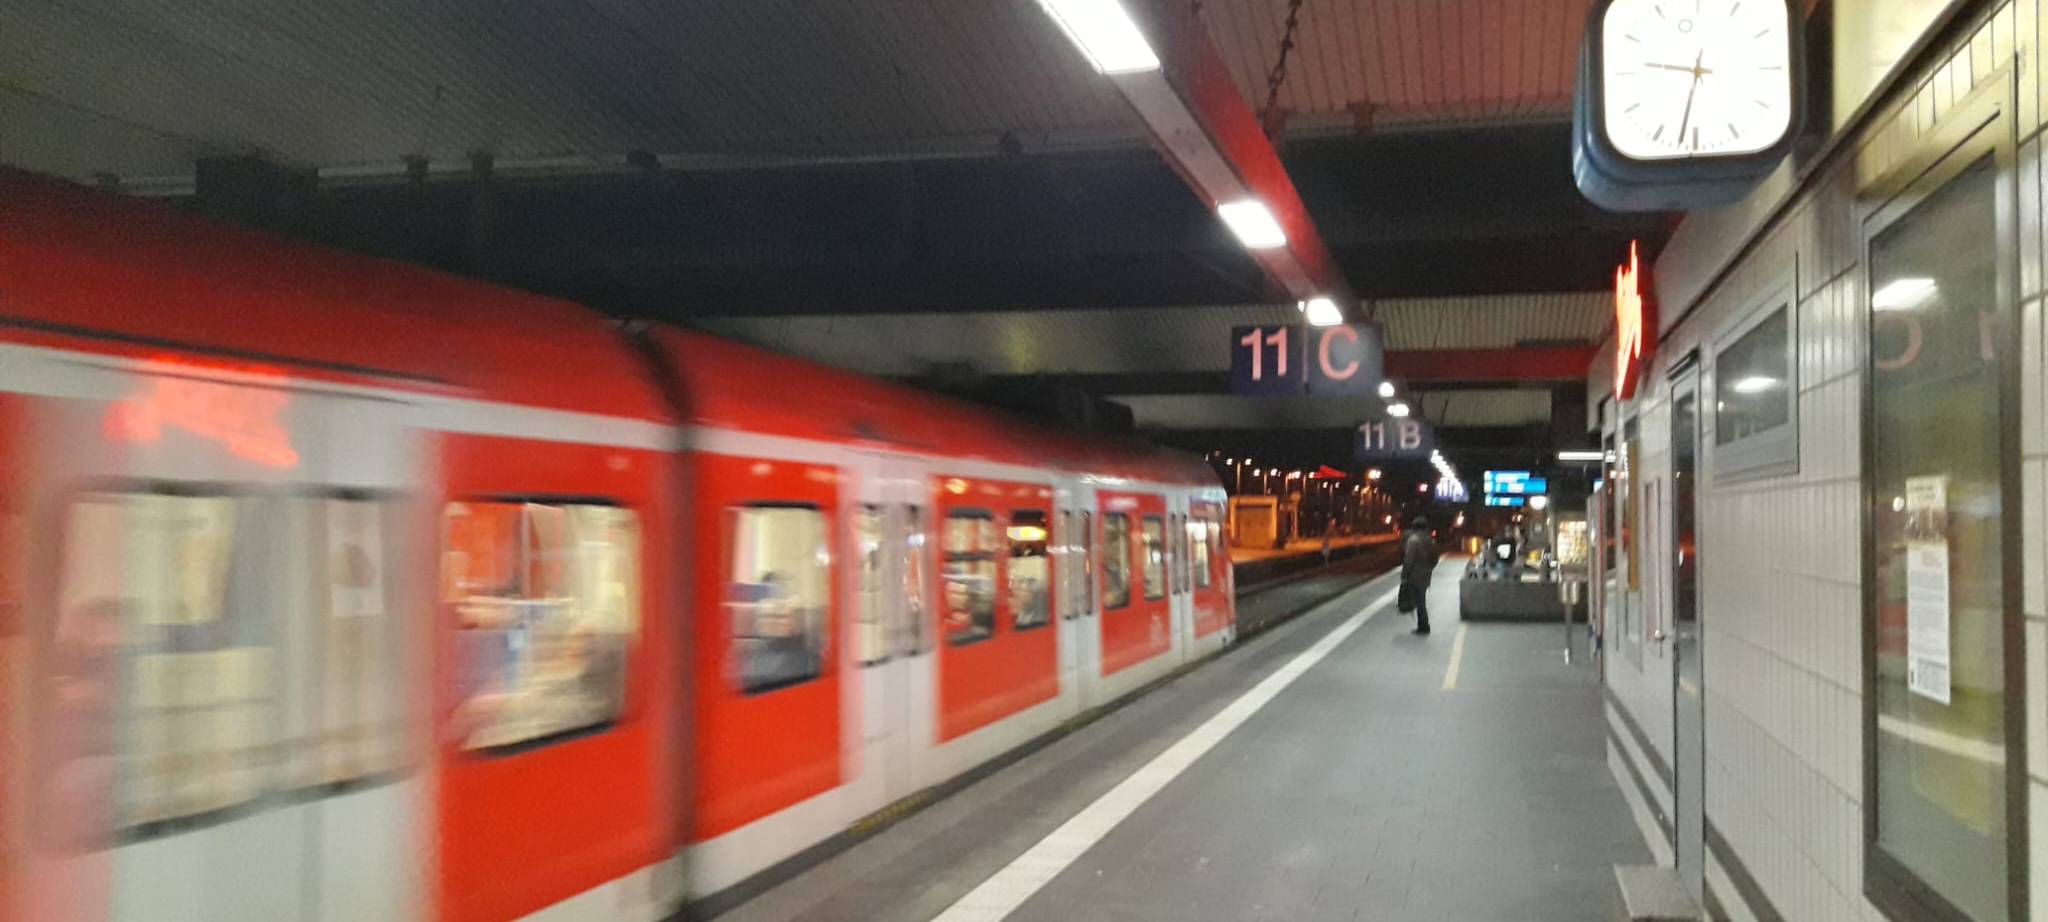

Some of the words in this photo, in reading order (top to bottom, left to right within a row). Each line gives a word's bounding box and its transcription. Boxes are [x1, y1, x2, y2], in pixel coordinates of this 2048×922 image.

[1241, 326, 1289, 381] 11
[1318, 326, 1360, 381] C
[1358, 421, 1385, 451] 11
[1399, 419, 1421, 450] B
